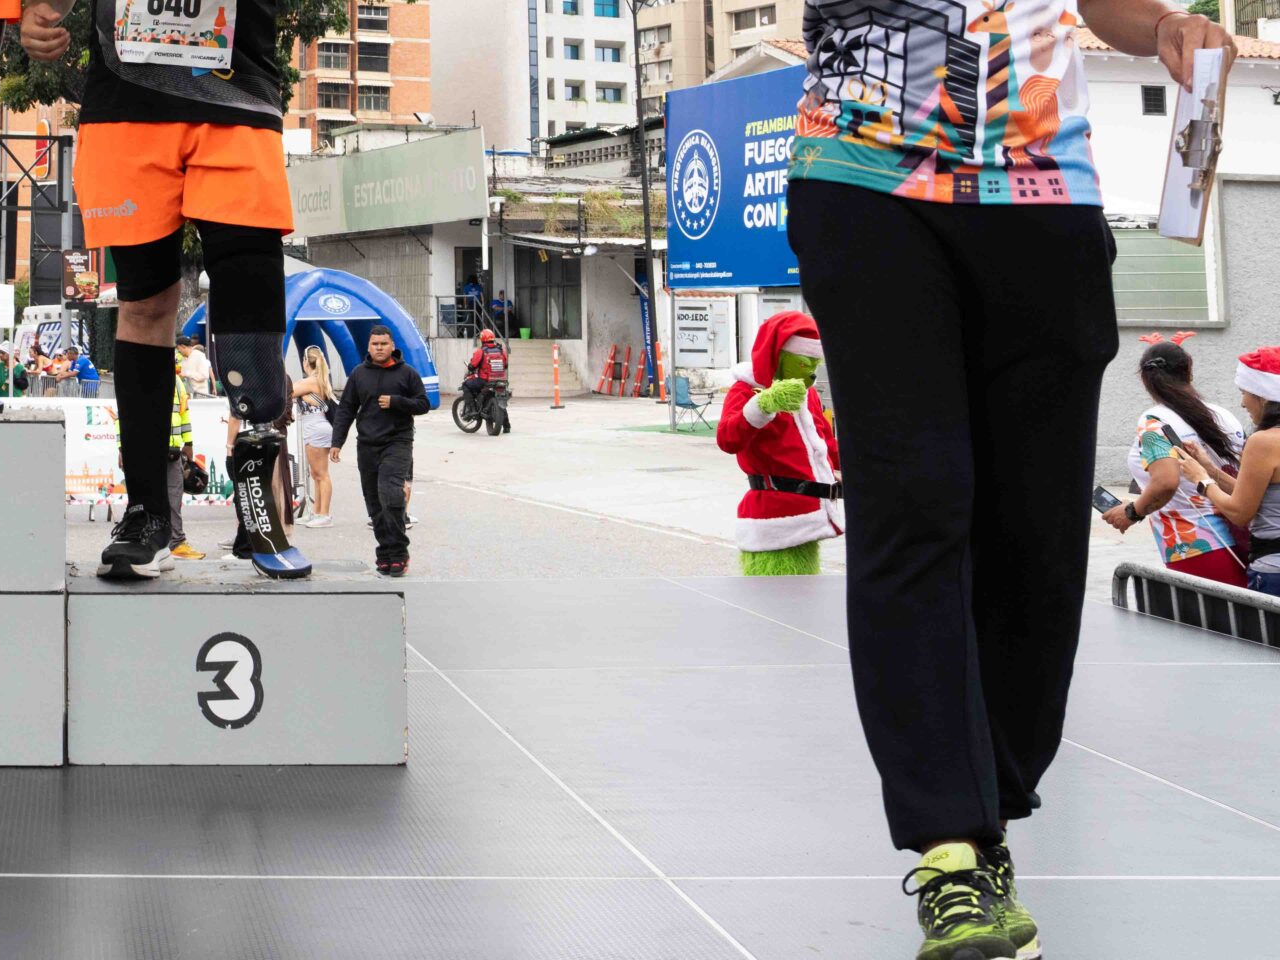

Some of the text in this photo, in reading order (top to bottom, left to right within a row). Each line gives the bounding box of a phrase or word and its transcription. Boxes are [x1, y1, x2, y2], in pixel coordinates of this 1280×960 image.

[353, 165, 477, 209] ESTACIONATO
[743, 201, 777, 229] CON
[249, 476, 272, 533] HOPPER
[196, 631, 264, 730] 3
